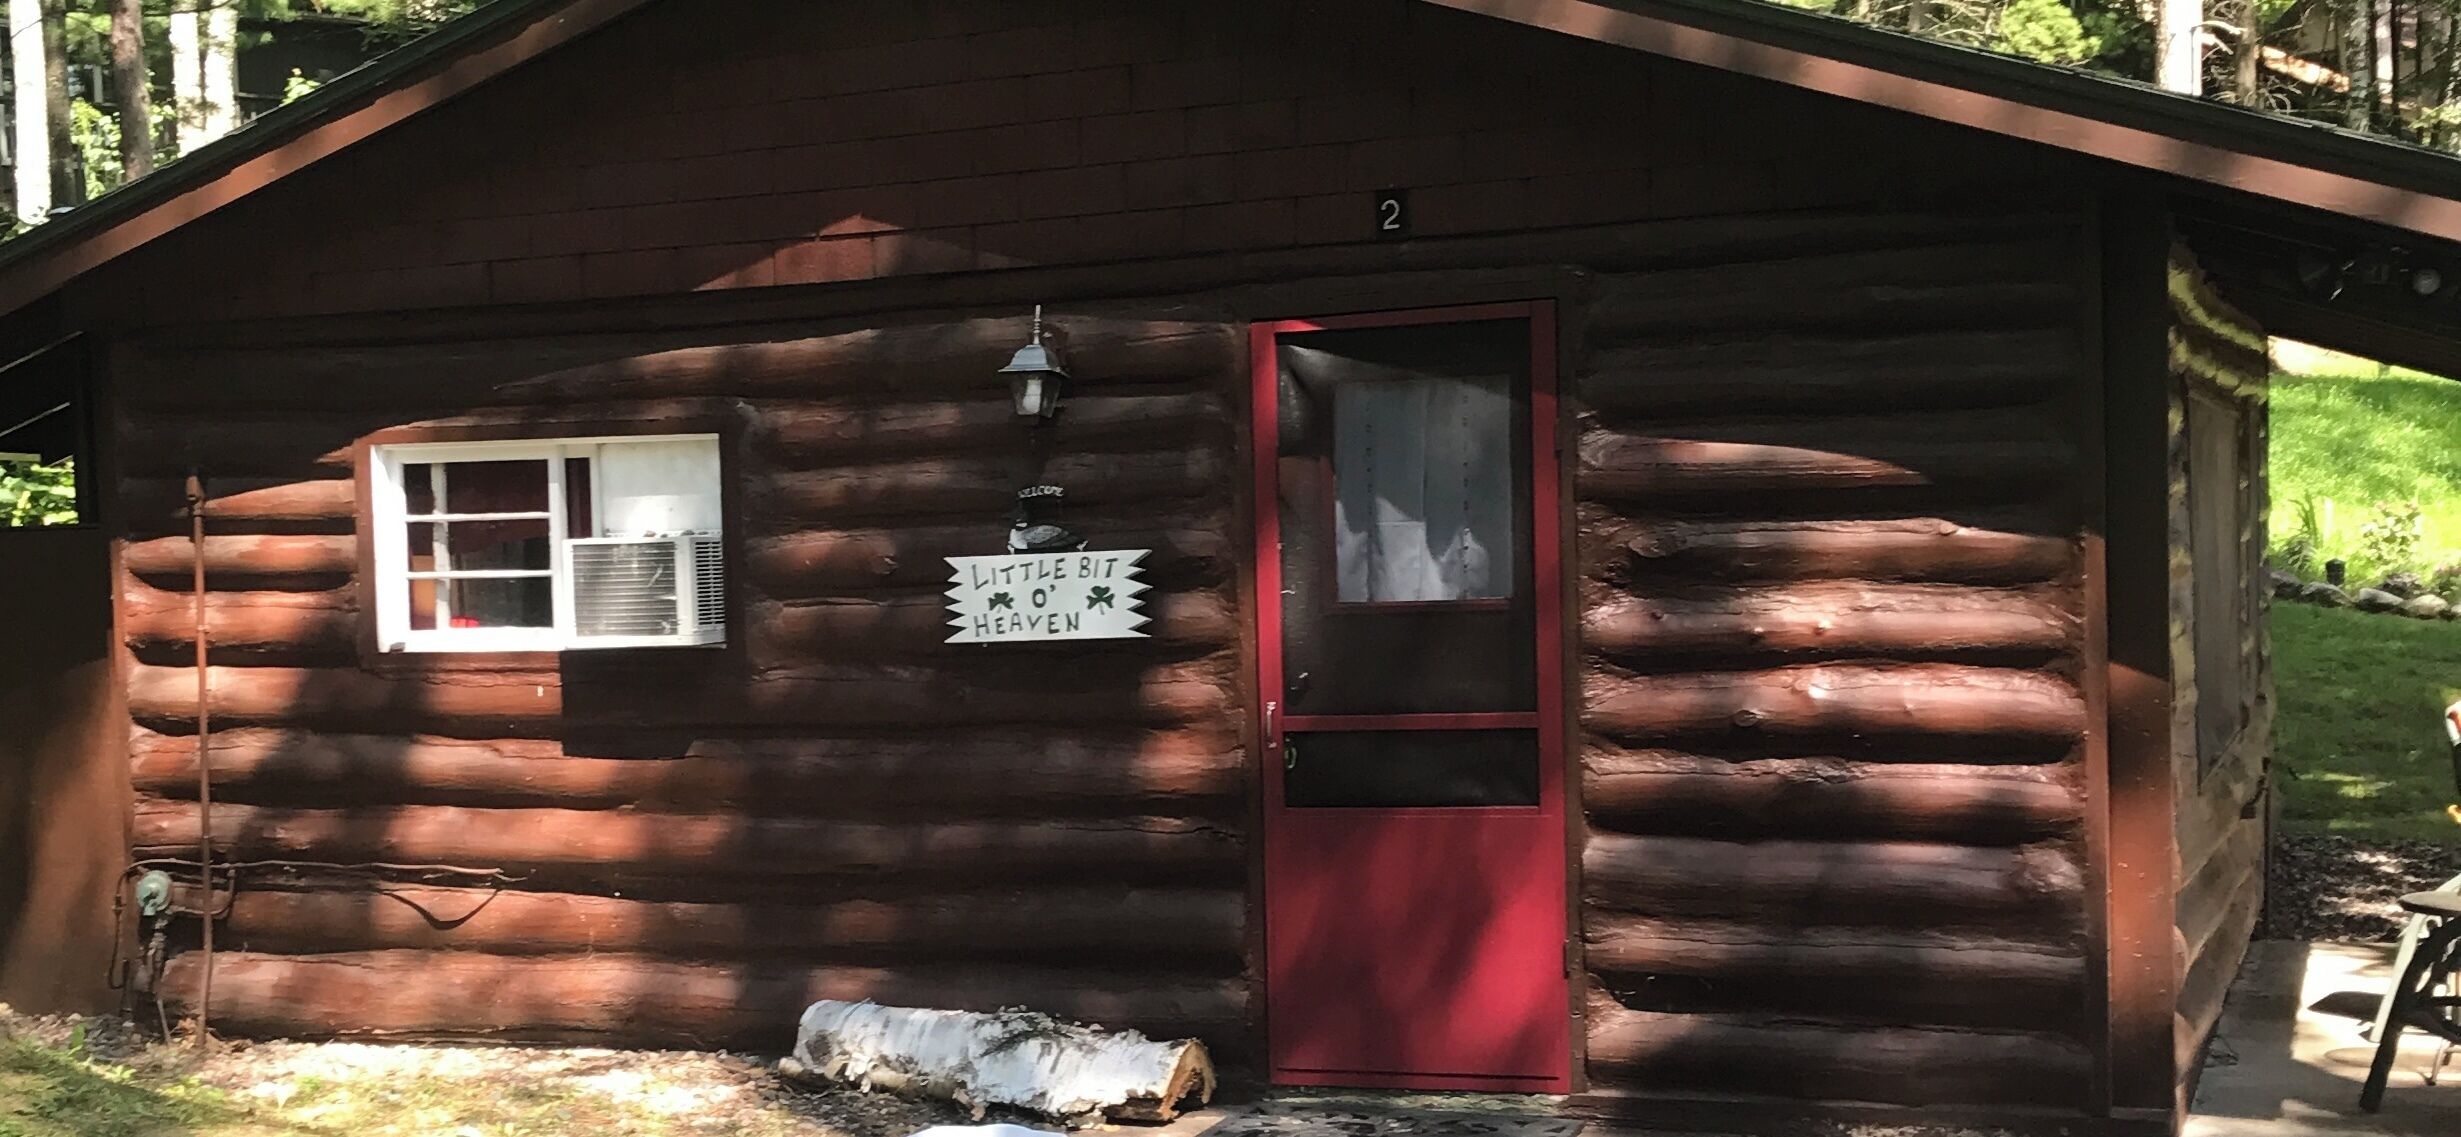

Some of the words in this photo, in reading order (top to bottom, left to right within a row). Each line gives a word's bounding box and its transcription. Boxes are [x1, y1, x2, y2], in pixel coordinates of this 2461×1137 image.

[1381, 200, 1400, 230] 2
[971, 557, 1066, 590] LITTLE
[1078, 556, 1118, 579] BIT
[1032, 584, 1056, 608] O'
[974, 612, 1080, 637] HEAVEN
